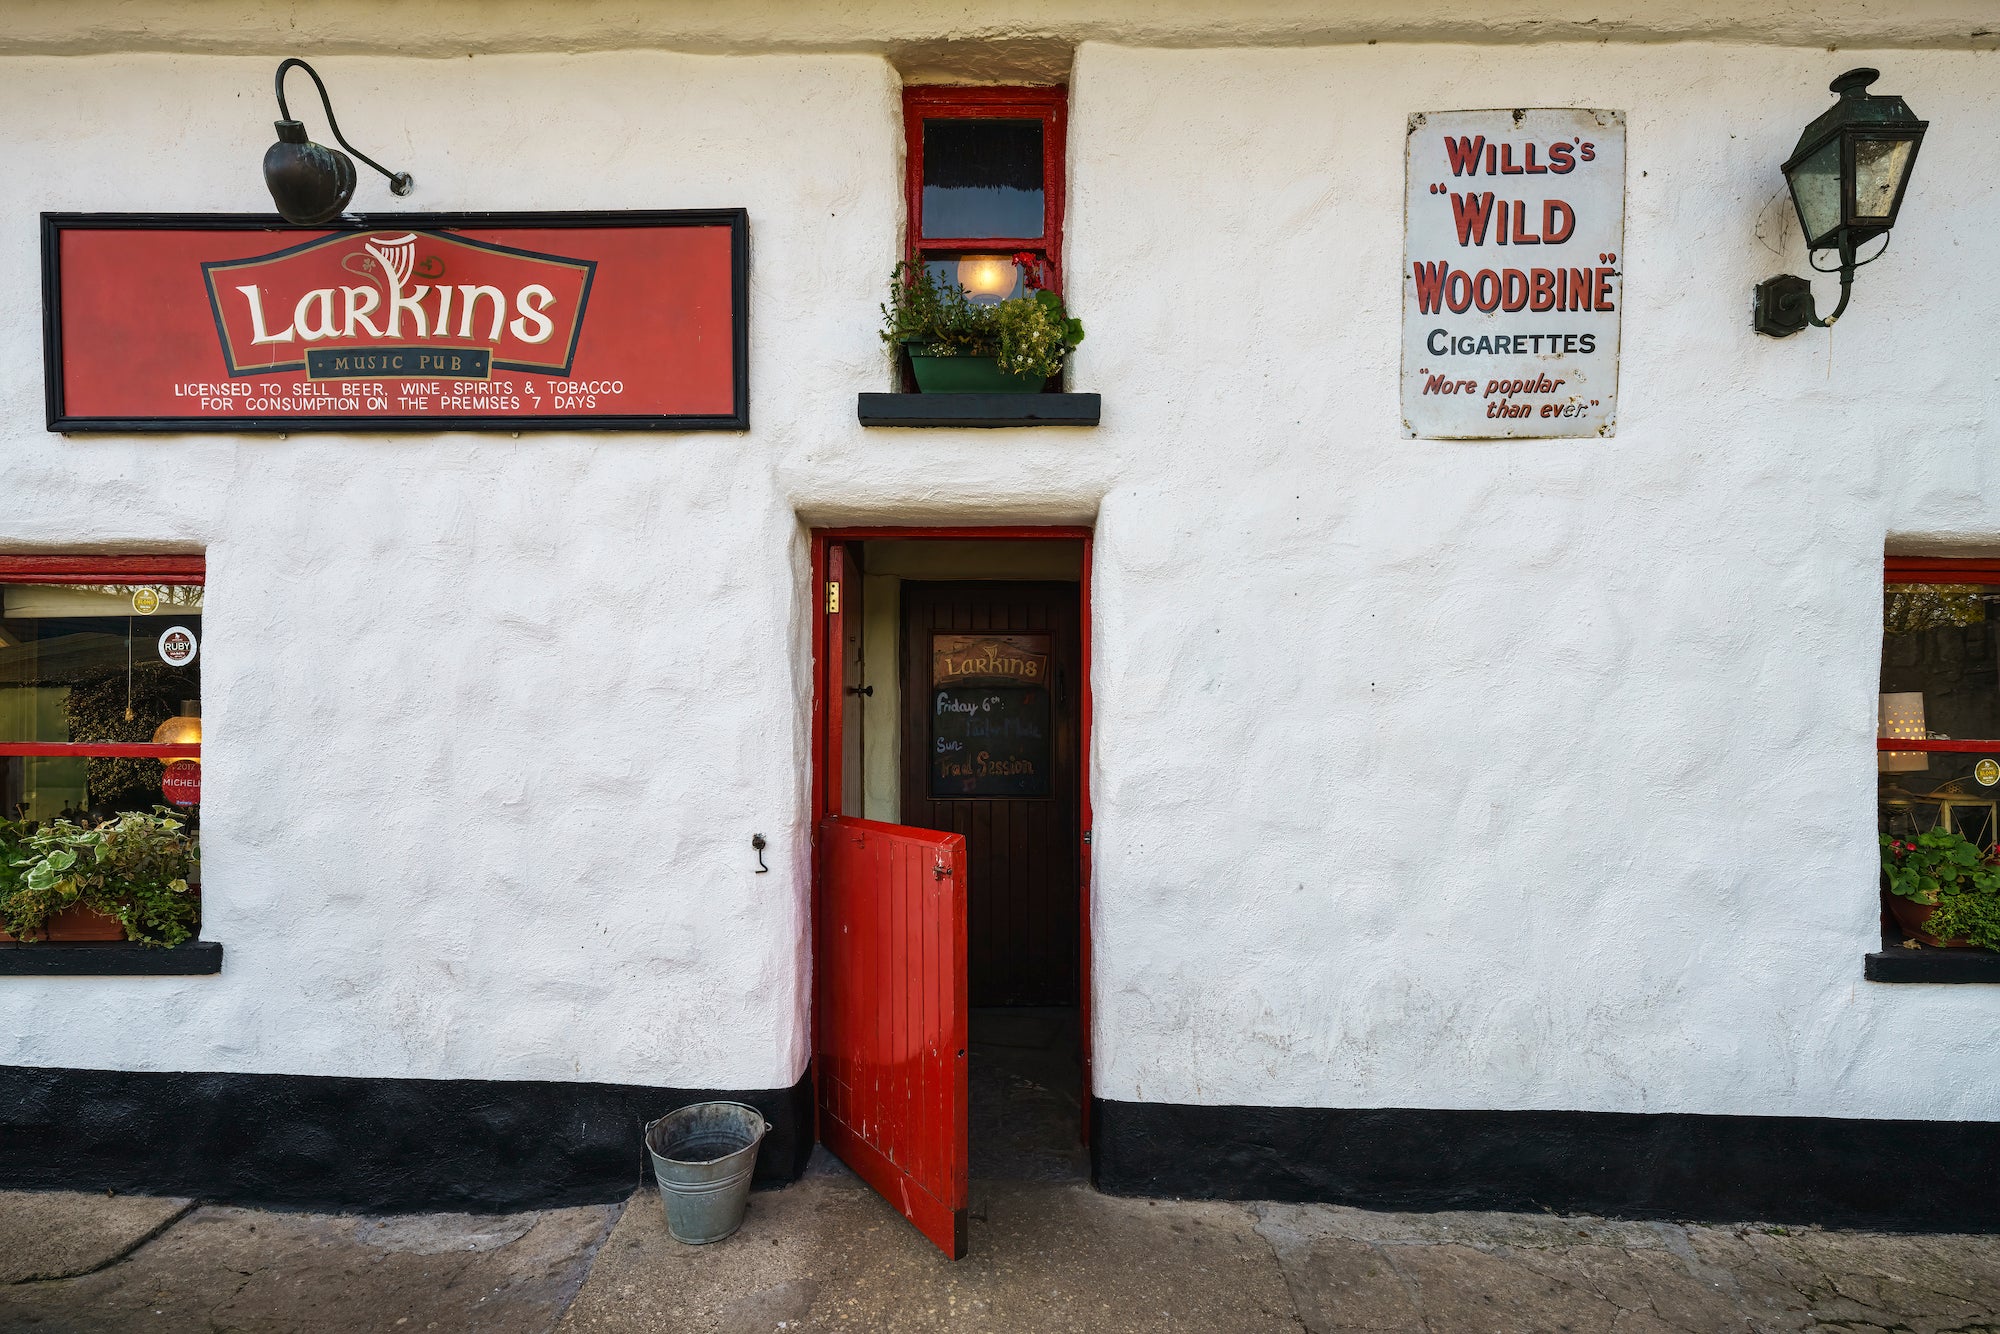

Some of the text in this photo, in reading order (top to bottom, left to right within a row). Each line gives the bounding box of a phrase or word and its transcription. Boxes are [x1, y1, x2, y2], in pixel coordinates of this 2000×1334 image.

[1429, 182, 1576, 247] "WILD
[235, 232, 556, 345] Larkins
[1413, 252, 1617, 315] WOODBINE"
[1427, 328, 1597, 356] CIGARETTES
[334, 355, 462, 371] MUSIC PUB
[174, 383, 252, 397] LICENSED
[260, 383, 282, 396] TO
[292, 383, 329, 396] SELL
[453, 382, 513, 395] SPIRITS
[524, 382, 535, 395] &
[547, 381, 624, 395] TOBACCO
[1419, 368, 1566, 398] "More popular
[201, 395, 596, 411] FOR CONSUMPTION ON THE PREMISES 7 DAYS
[1486, 398, 1532, 418] than
[165, 642, 190, 651] RUBY
[945, 644, 1037, 677] Larkins
[936, 691, 979, 716] Friday
[976, 751, 1034, 777] Session
[163, 778, 200, 788] MICHELI
